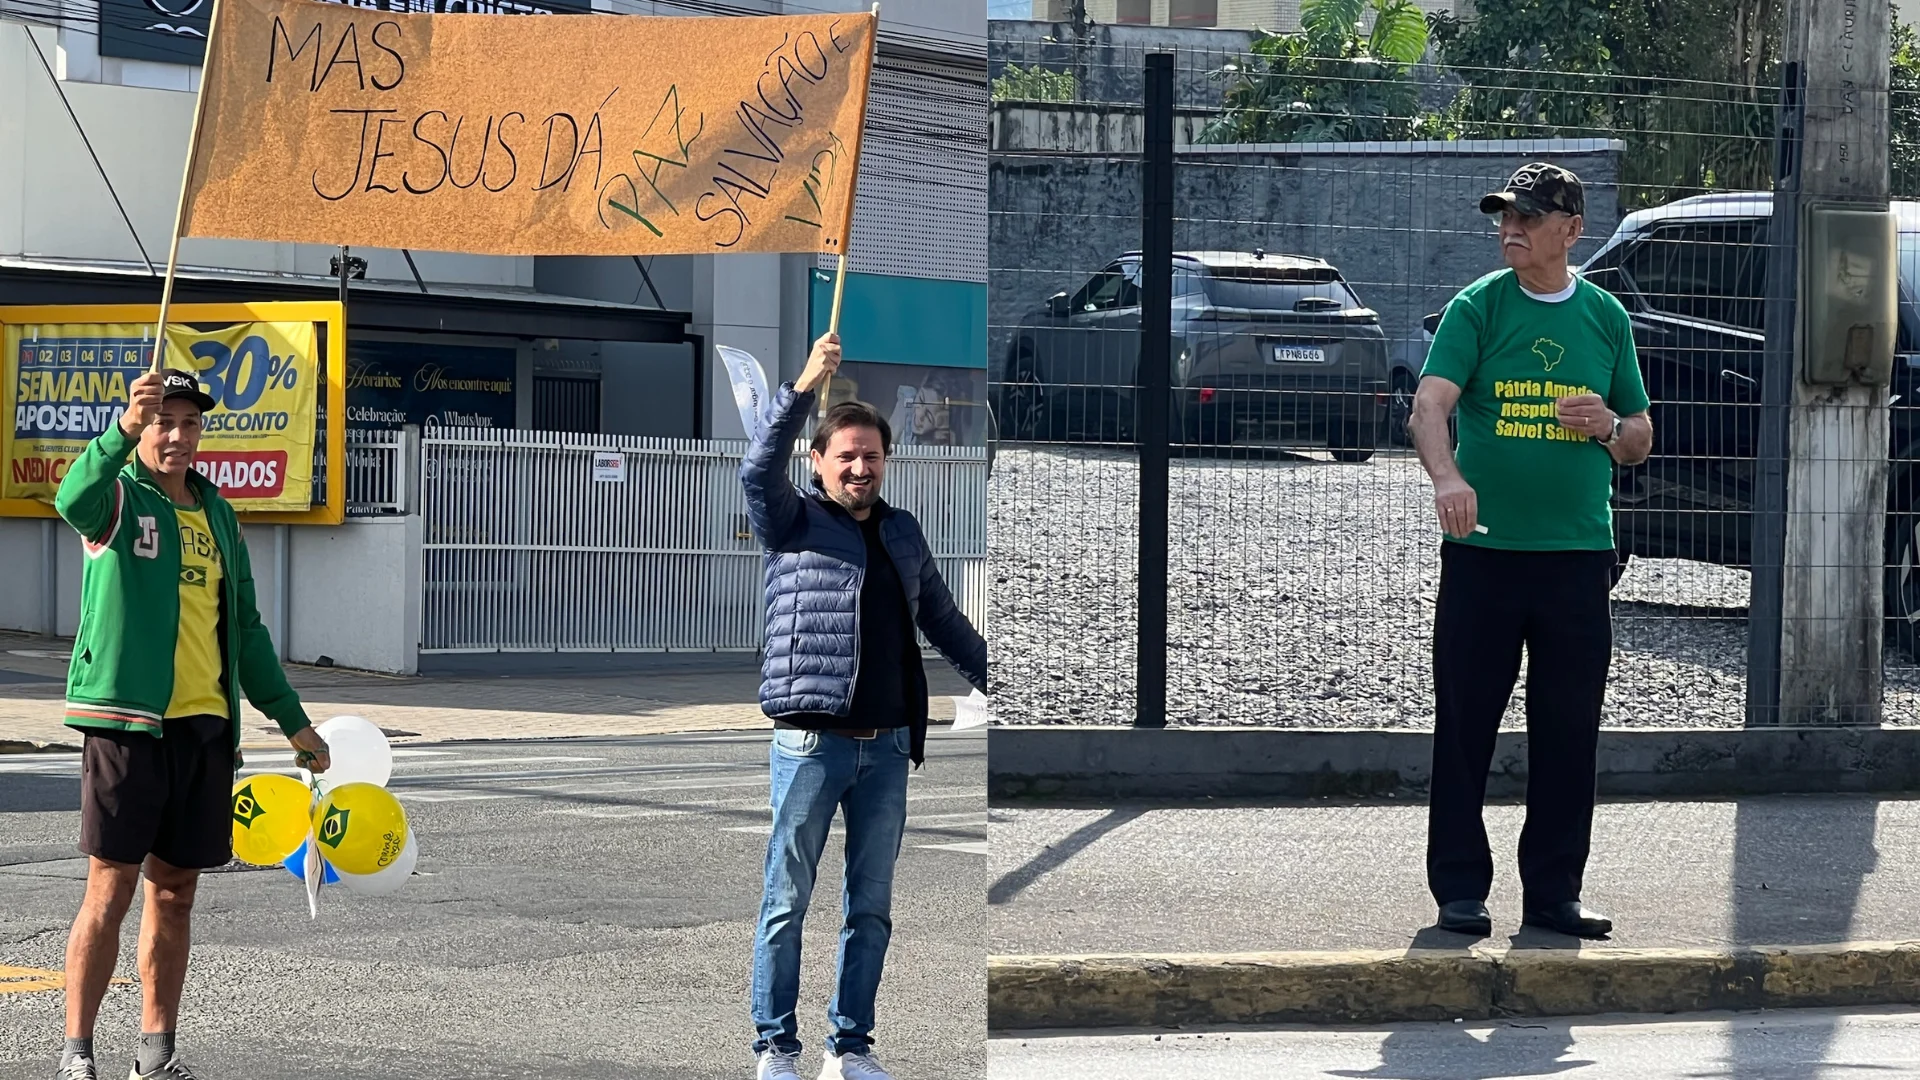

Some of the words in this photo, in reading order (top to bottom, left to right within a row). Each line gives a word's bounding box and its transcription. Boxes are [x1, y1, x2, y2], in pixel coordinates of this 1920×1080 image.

[265, 15, 405, 92] MAS
[312, 109, 526, 200] JESUS
[531, 86, 619, 192] DÁ
[695, 31, 828, 248] SALVAÇÃO
[829, 18, 851, 53] E
[597, 83, 704, 238] PAZ
[39, 350, 54, 363] 02
[60, 350, 72, 363] 03
[81, 350, 95, 363] 04
[102, 350, 114, 362] 05
[124, 350, 138, 363] 06
[18, 371, 128, 403] SEMANA
[189, 336, 298, 411] 30%
[449, 379, 490, 392] encontre
[490, 377, 512, 395] aqui:
[1494, 379, 1541, 398] Pátria
[346, 405, 406, 427] Celebração:
[444, 411, 493, 428] WhatsApp:
[1495, 419, 1543, 439] Salve!
